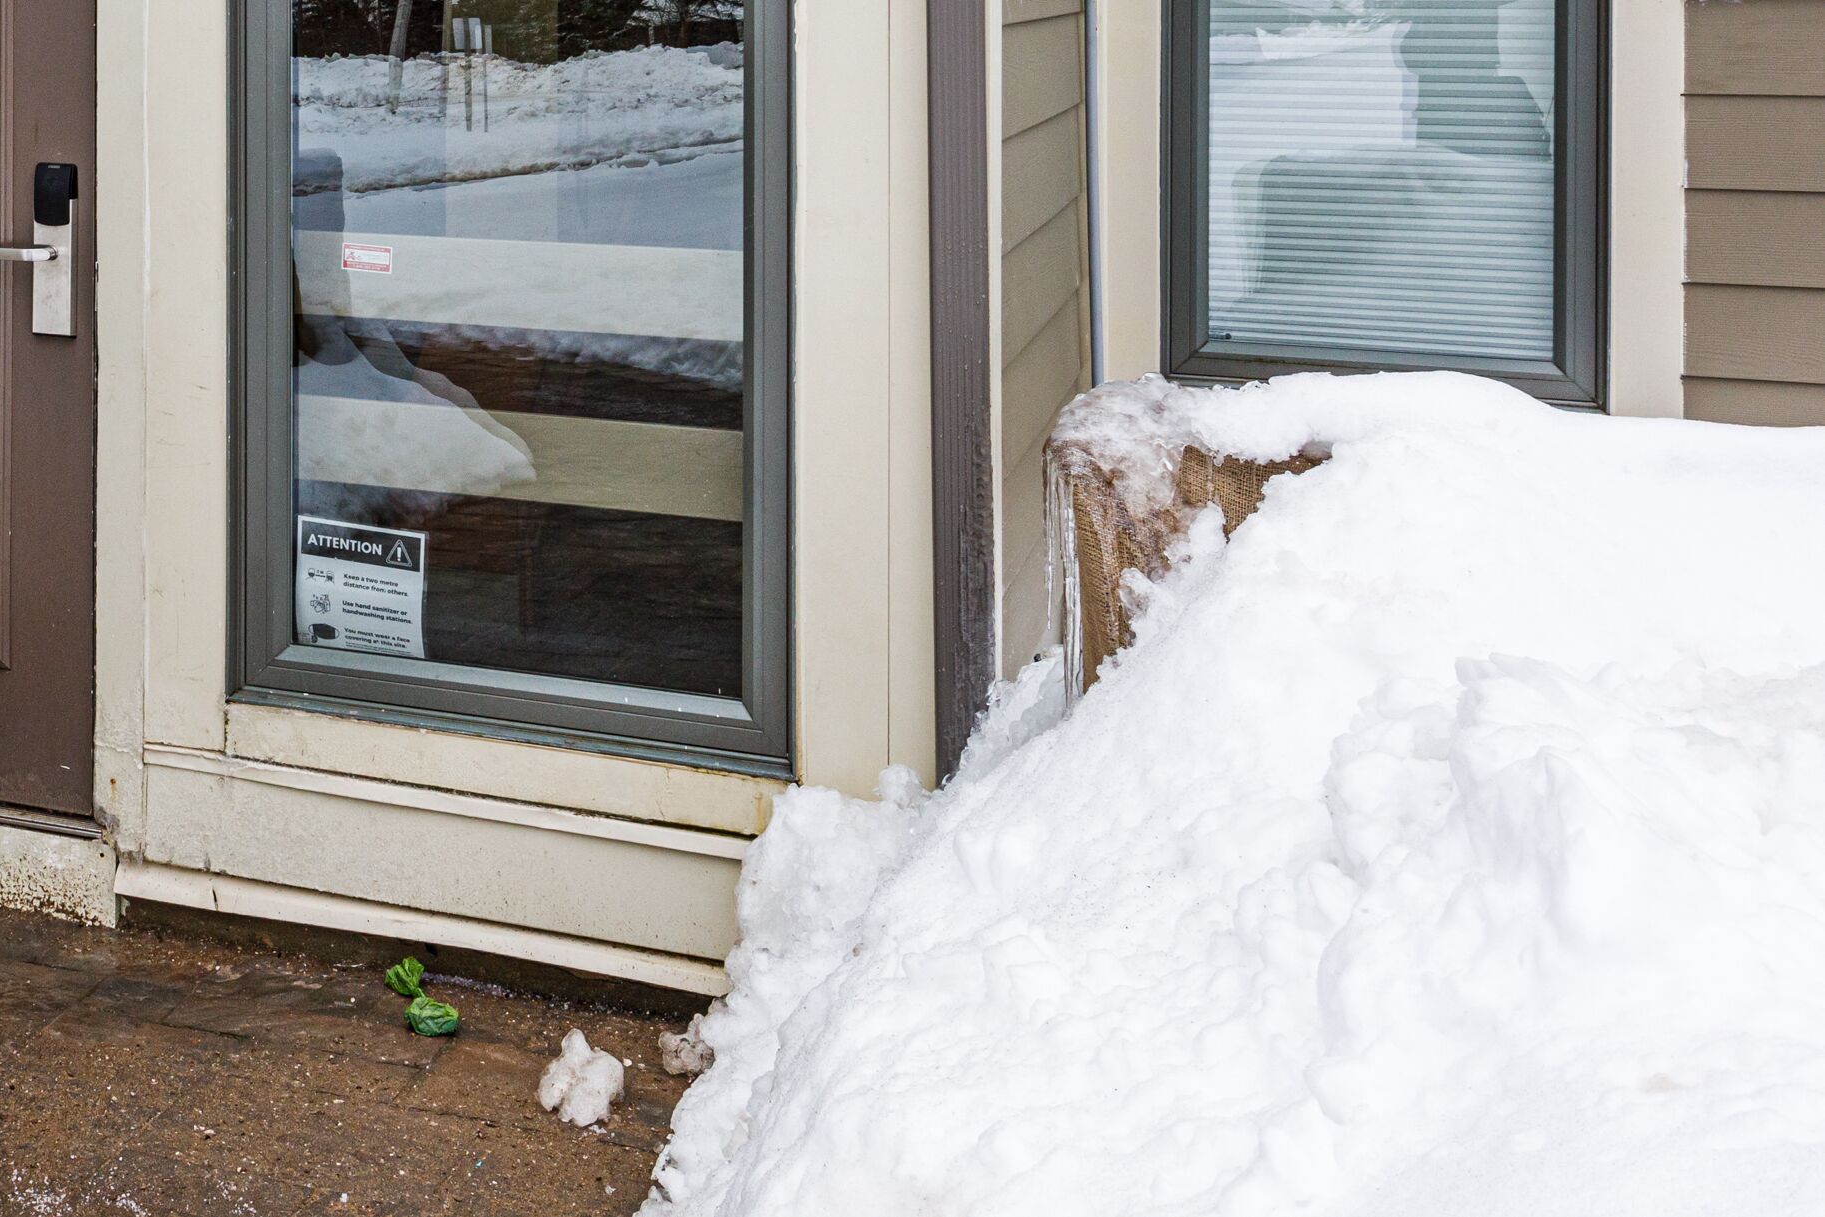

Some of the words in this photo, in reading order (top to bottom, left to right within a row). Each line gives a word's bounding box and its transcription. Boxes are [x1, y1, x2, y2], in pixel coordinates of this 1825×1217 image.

[307, 534, 382, 556] ATTENTION
[343, 581, 370, 590] distance
[387, 589, 409, 597] others.
[343, 608, 384, 620] handwashing
[386, 615, 413, 624] stations.
[372, 605, 399, 614] sanitizer
[345, 635, 371, 643] covering
